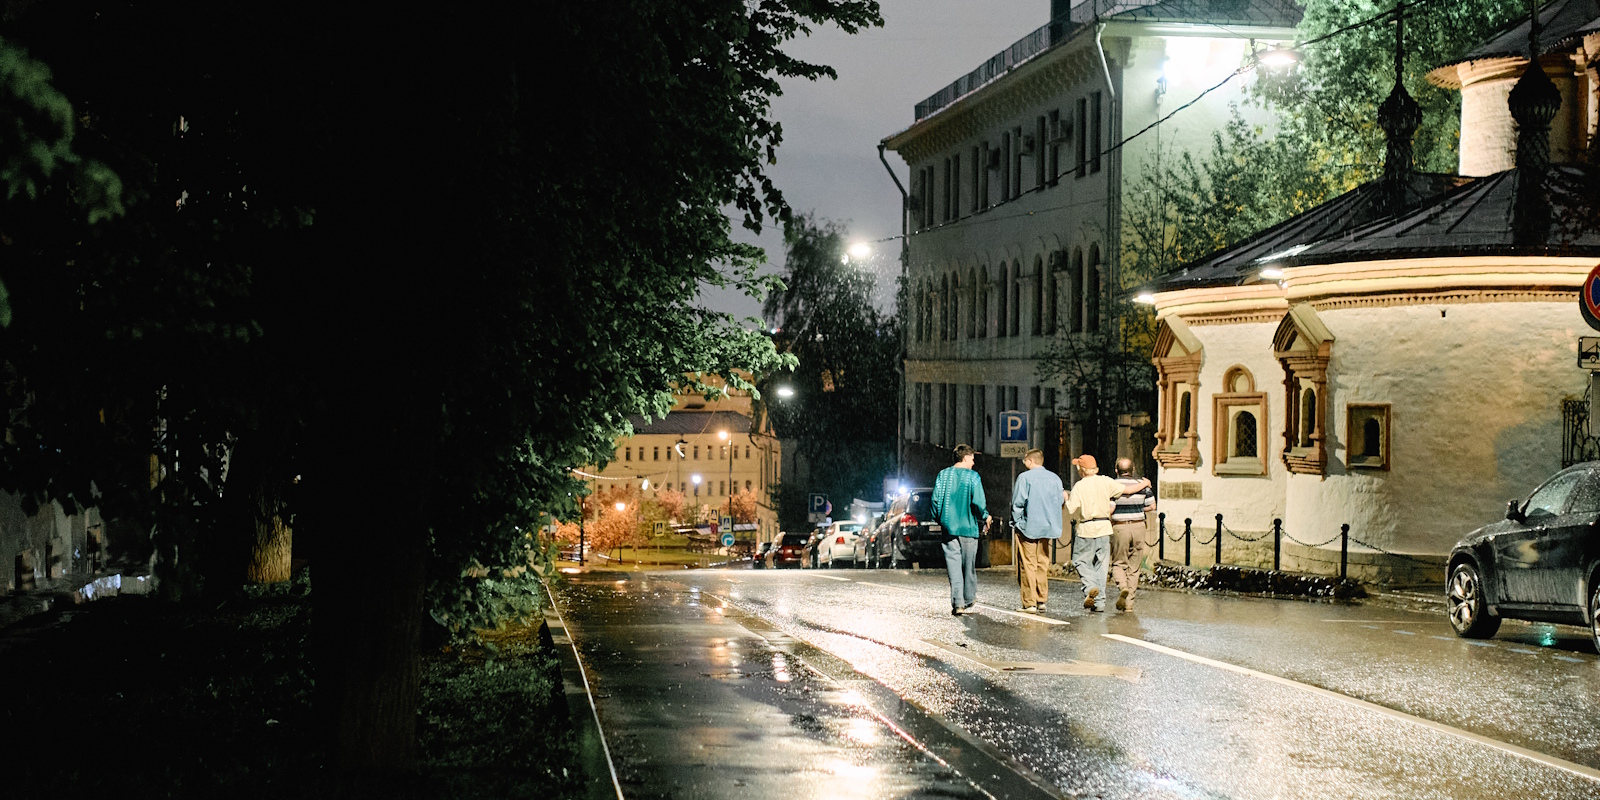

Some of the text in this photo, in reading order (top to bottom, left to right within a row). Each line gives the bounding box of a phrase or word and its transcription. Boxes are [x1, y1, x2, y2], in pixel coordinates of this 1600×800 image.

[1007, 416, 1022, 438] P
[1017, 446, 1026, 454] 20
[814, 495, 824, 510] P
